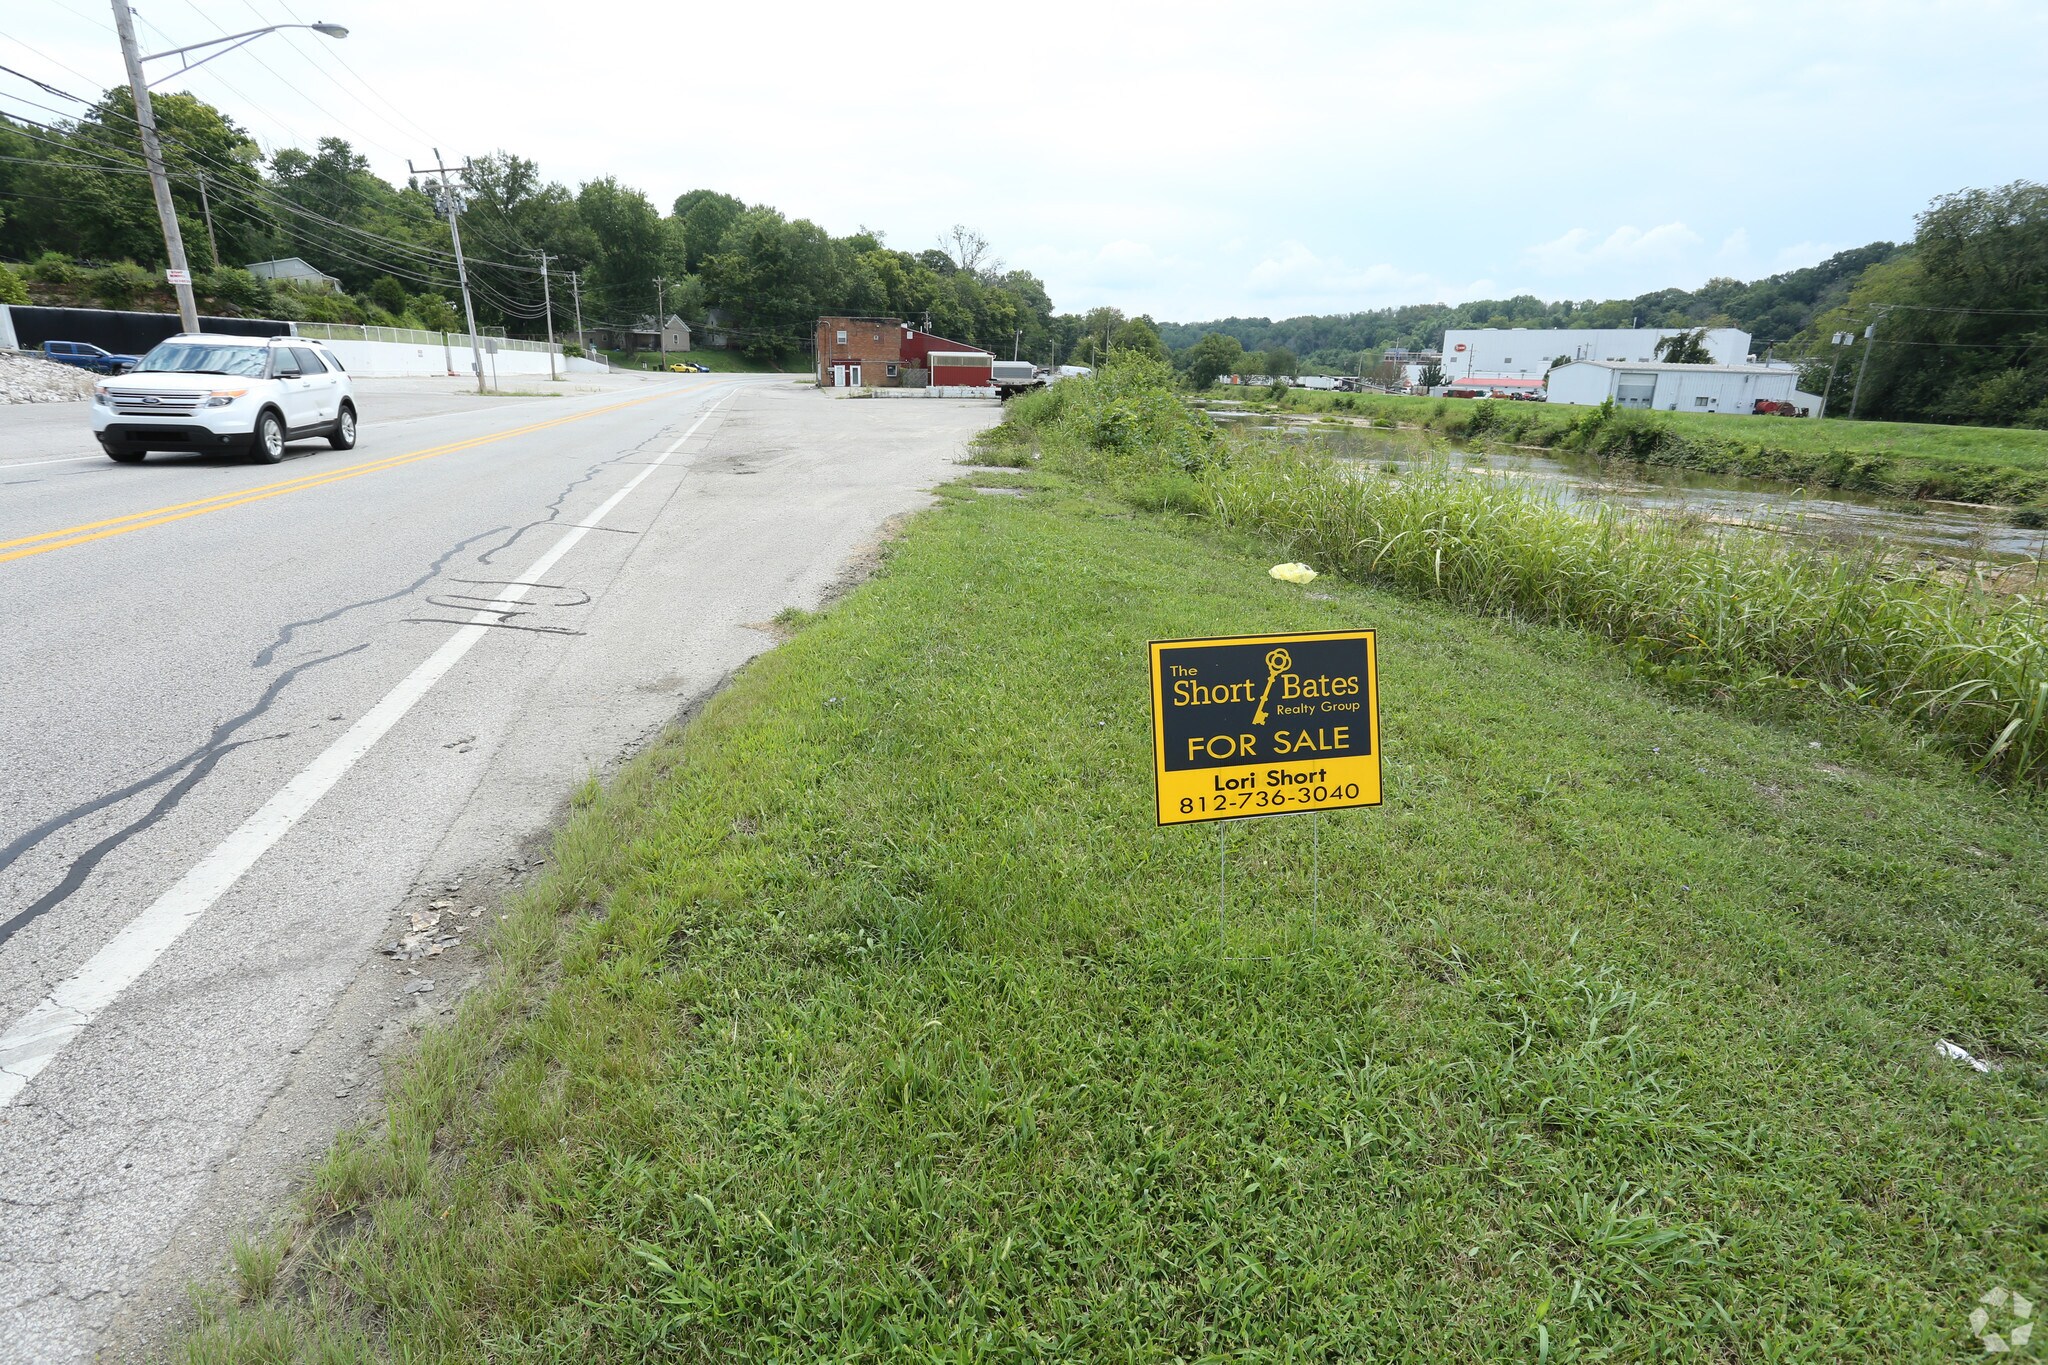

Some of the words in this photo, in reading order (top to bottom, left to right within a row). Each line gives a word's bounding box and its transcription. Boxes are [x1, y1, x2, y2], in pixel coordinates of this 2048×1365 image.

[1170, 665, 1198, 676] The
[1173, 679, 1255, 707] Short
[1281, 673, 1359, 700] Bates
[1277, 703, 1316, 716] Realty
[1320, 701, 1360, 713] Group
[1188, 734, 1257, 761] FOR
[1273, 726, 1349, 754] SALE
[1214, 772, 1256, 791] Lori
[1266, 768, 1327, 787] Short
[1179, 783, 1359, 814] 812-736-3040
